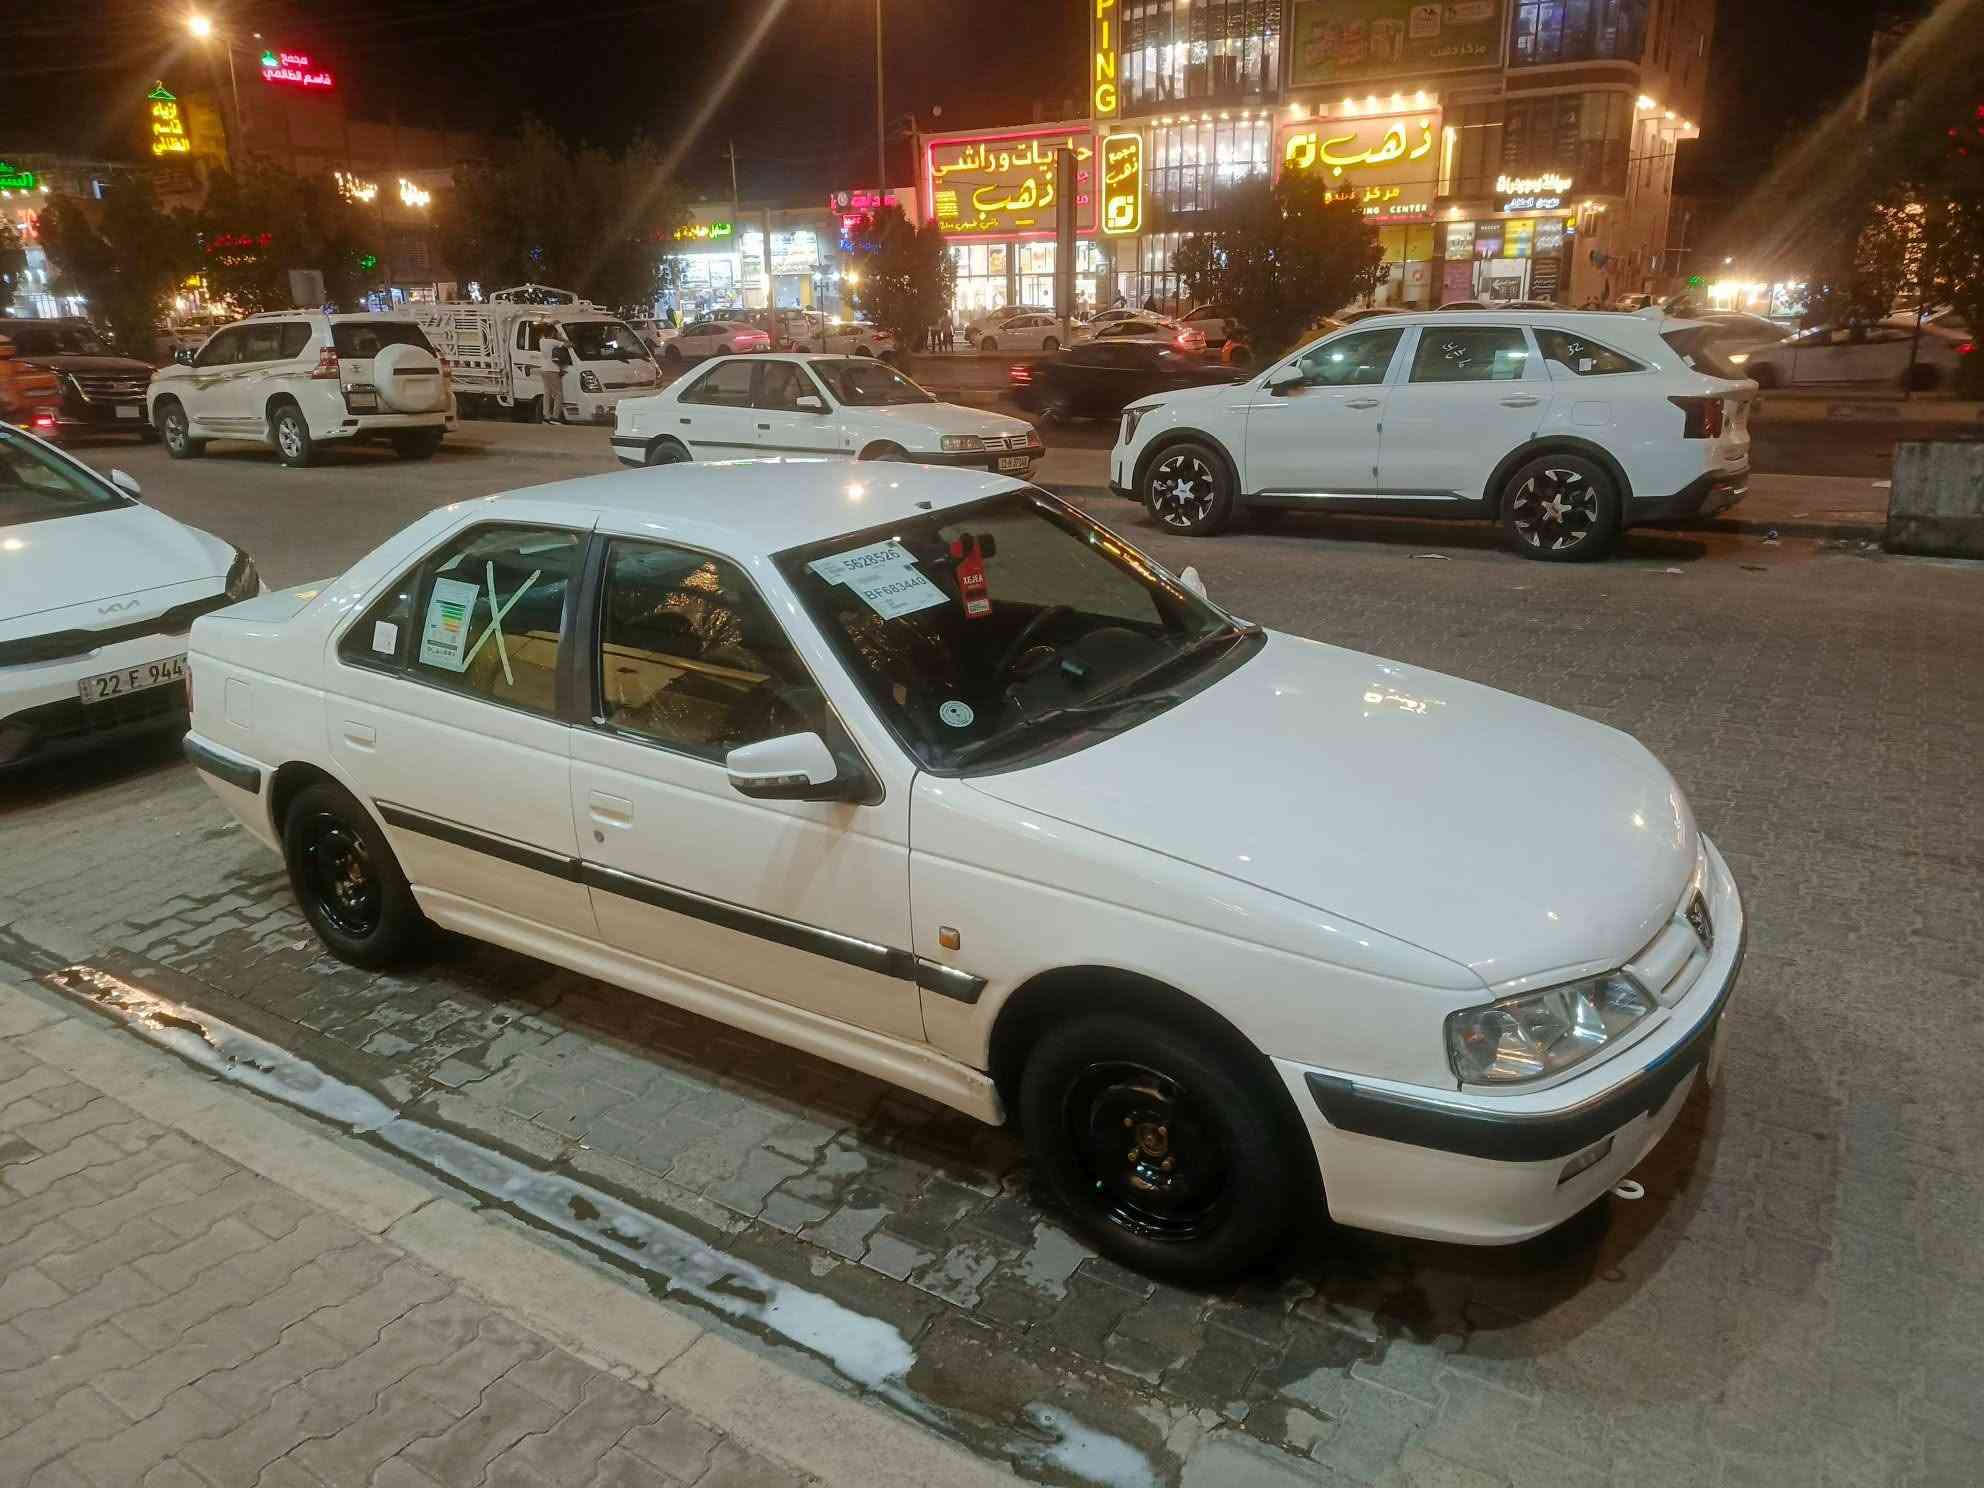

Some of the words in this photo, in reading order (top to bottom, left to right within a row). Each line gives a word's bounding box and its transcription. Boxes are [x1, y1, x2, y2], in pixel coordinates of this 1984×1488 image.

[1109, 145, 1137, 165] مجمع
[1319, 118, 1433, 177] ذهب
[1106, 157, 1139, 188] ذهب
[972, 171, 1055, 220] ذهب
[1363, 187, 1401, 202] مركز
[1389, 203, 1428, 214] CENTER
[96, 675, 122, 697] 22
[128, 669, 139, 688] F
